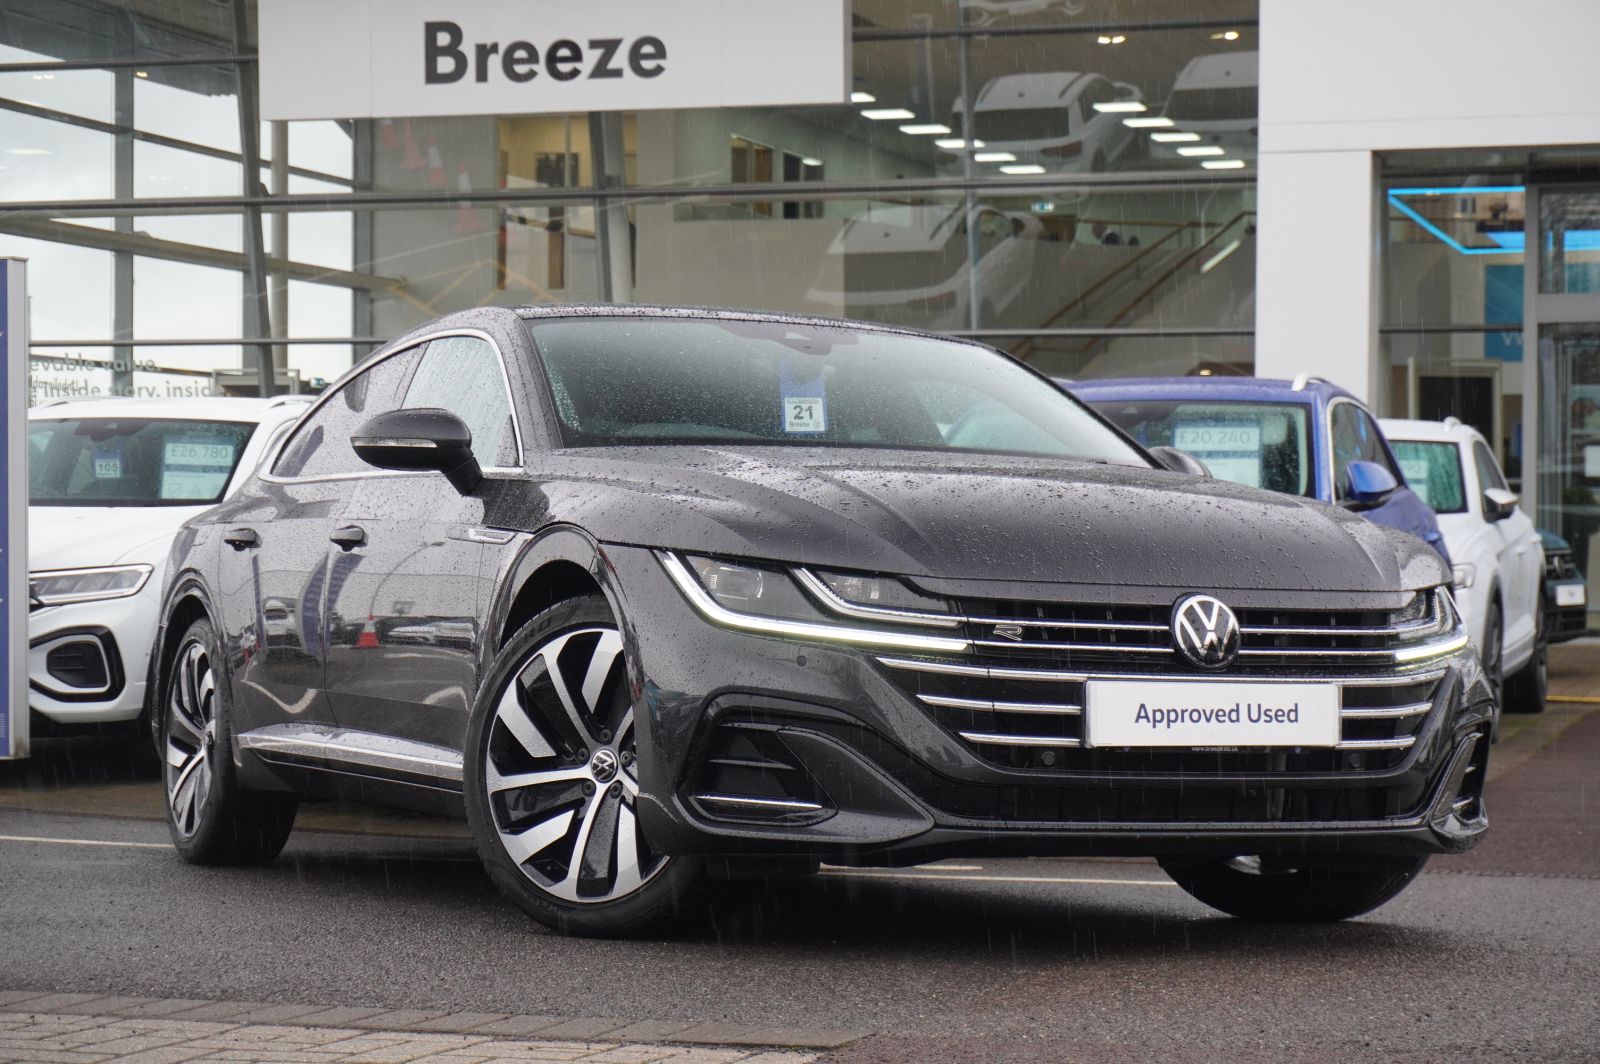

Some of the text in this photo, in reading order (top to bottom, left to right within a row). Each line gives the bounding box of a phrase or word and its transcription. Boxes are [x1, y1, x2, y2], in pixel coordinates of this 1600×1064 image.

[424, 20, 667, 85] Breeze
[793, 405, 813, 420] 21
[1179, 430, 1250, 445] £20,240
[98, 463, 118, 473] 105
[1134, 703, 1299, 729] Approved Used
